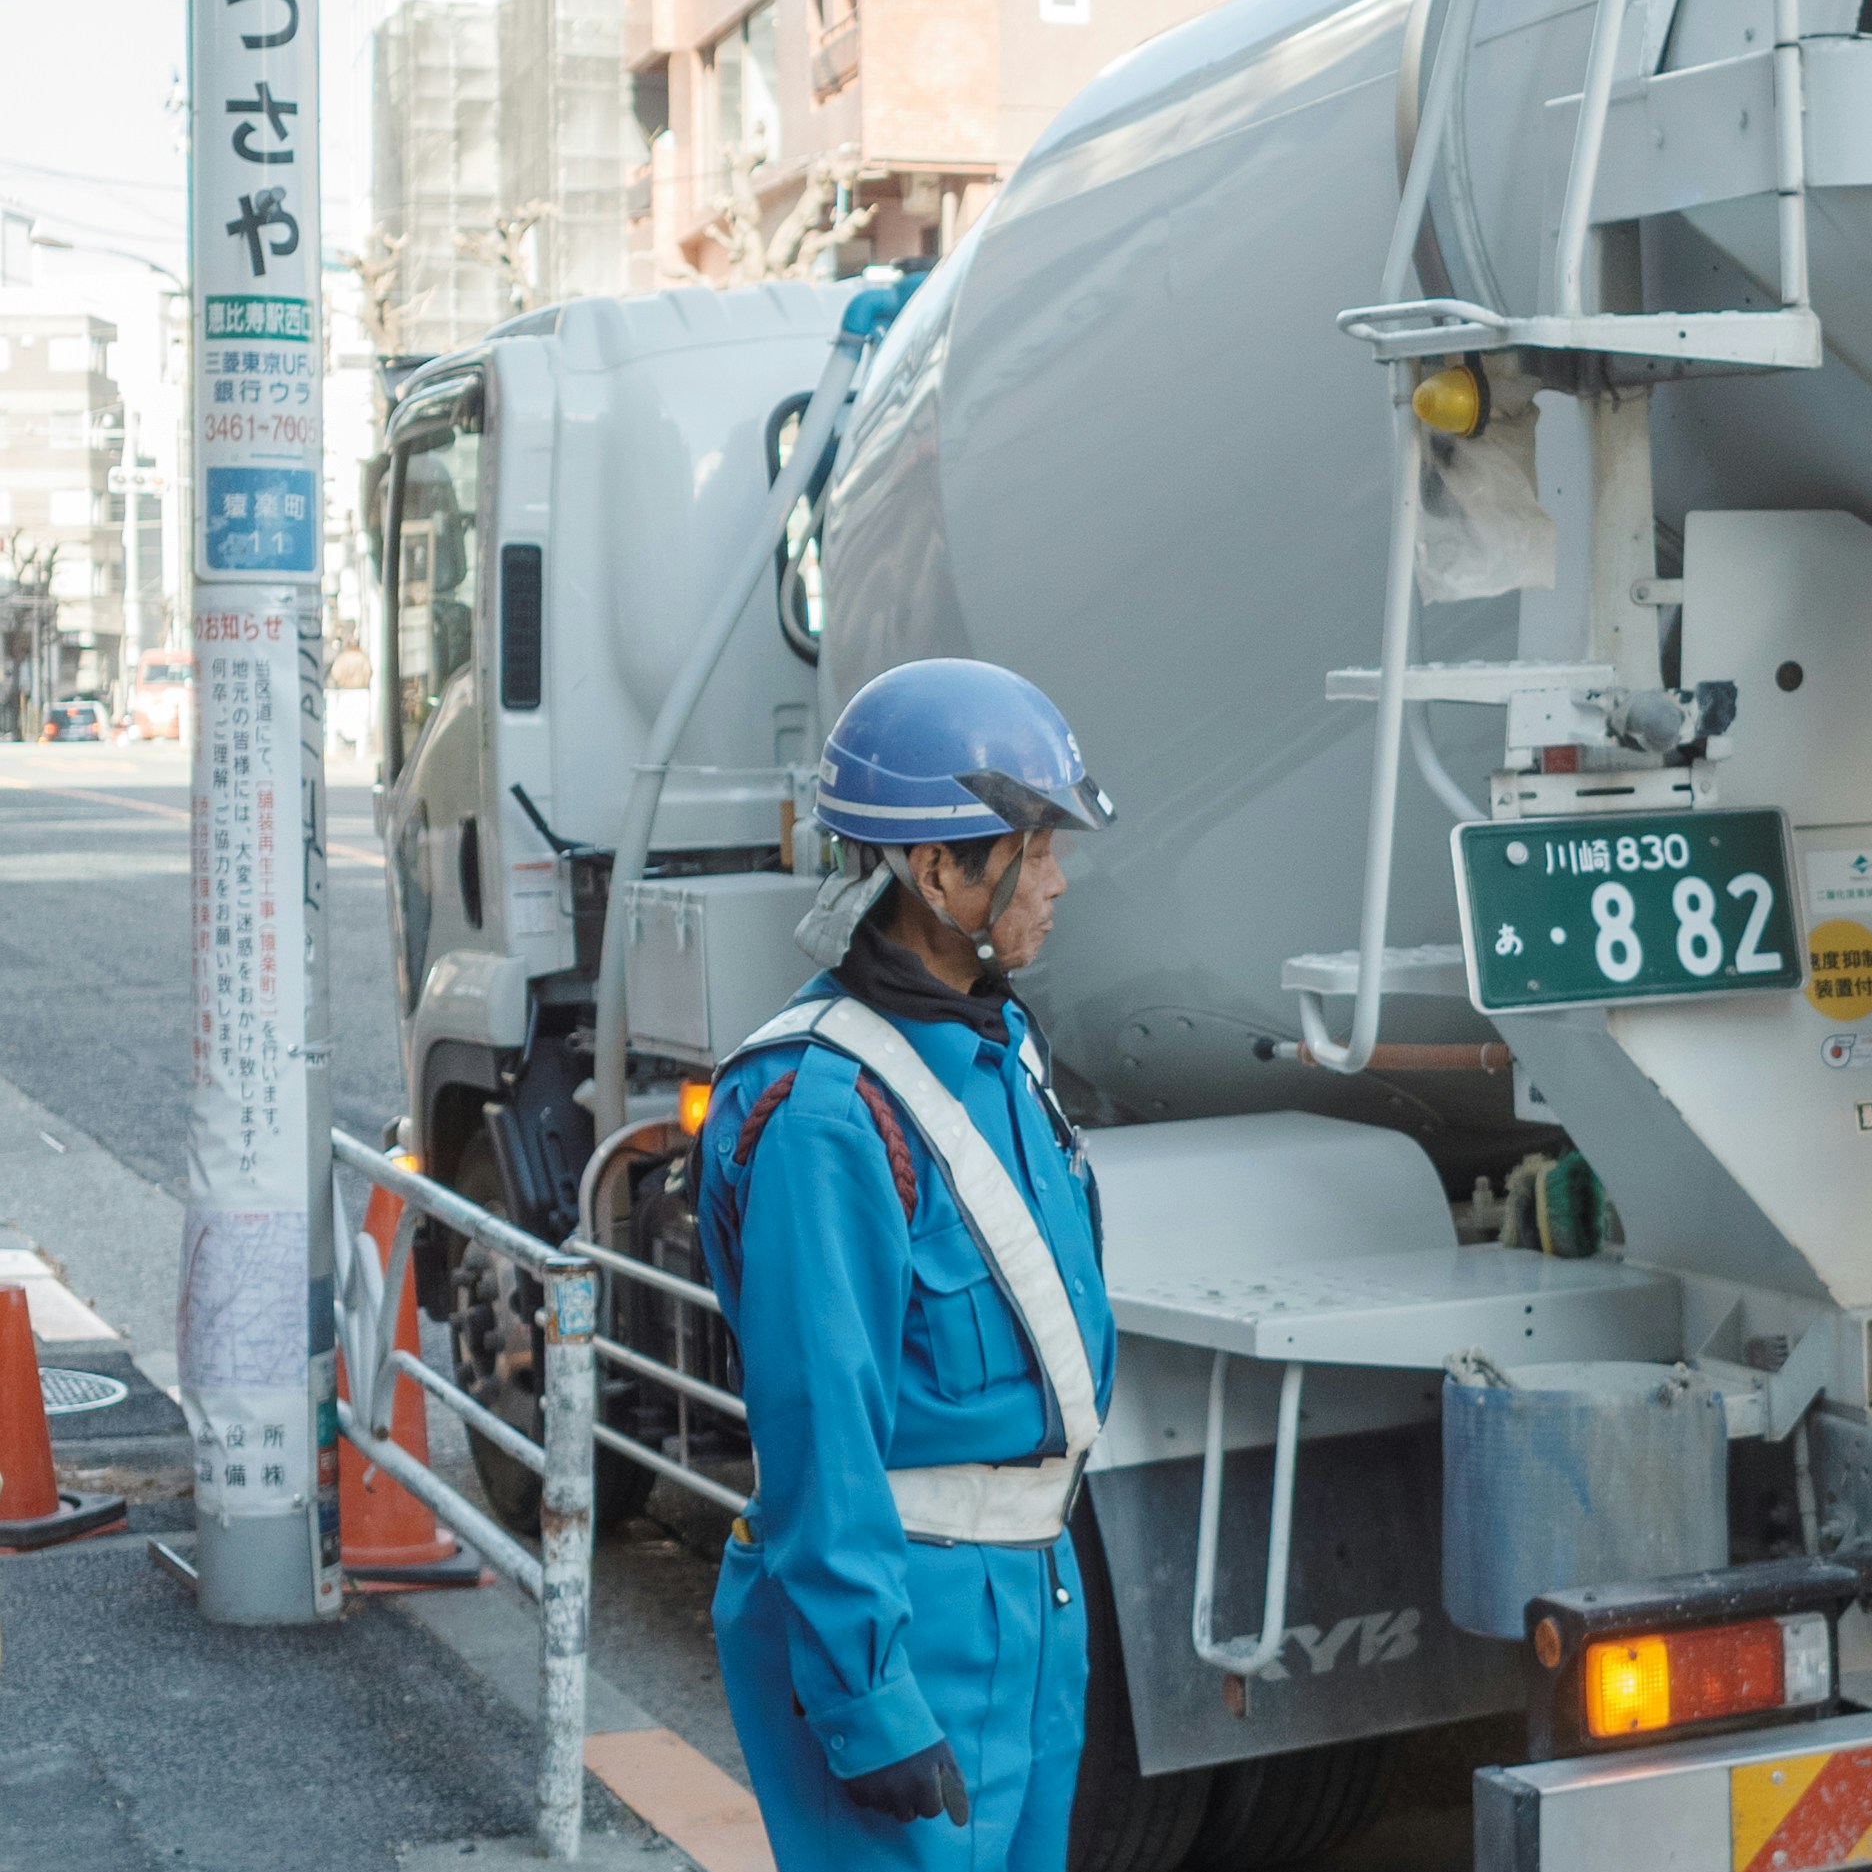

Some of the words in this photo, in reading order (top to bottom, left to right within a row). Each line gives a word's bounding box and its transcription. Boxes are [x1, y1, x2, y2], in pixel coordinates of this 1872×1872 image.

[206, 302, 315, 337] 恵比寿駅西口
[213, 380, 312, 405] 銀行ウラ
[222, 491, 307, 522] 猿楽町
[1545, 838, 1609, 876] 川崎
[1616, 833, 1690, 870] 830
[1494, 924, 1523, 956] あ
